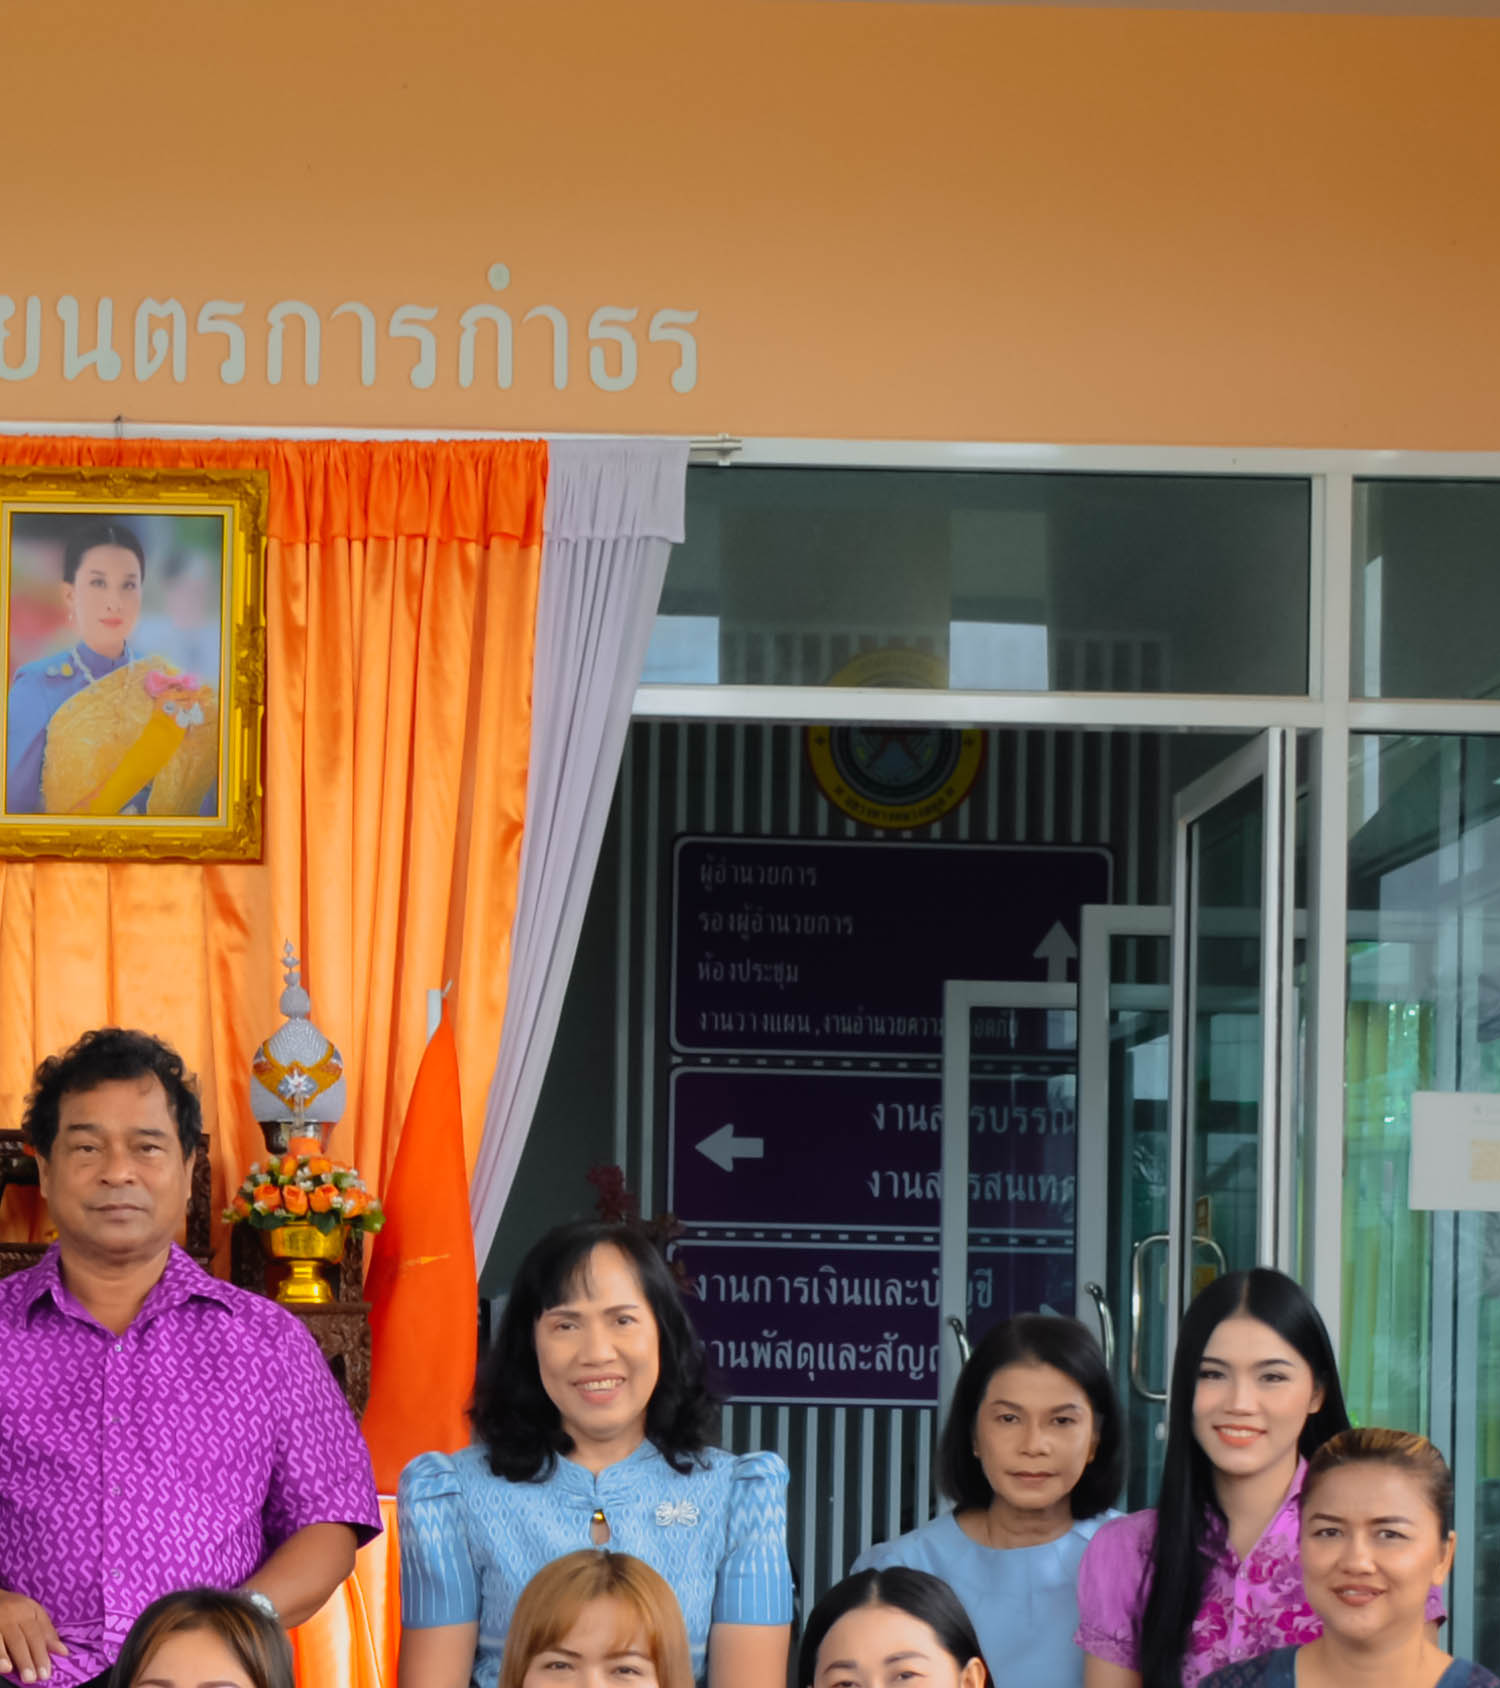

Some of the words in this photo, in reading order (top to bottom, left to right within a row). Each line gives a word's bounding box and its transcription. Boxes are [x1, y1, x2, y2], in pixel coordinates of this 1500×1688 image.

[694, 1264, 993, 1315] งานการเงินและบัชี
